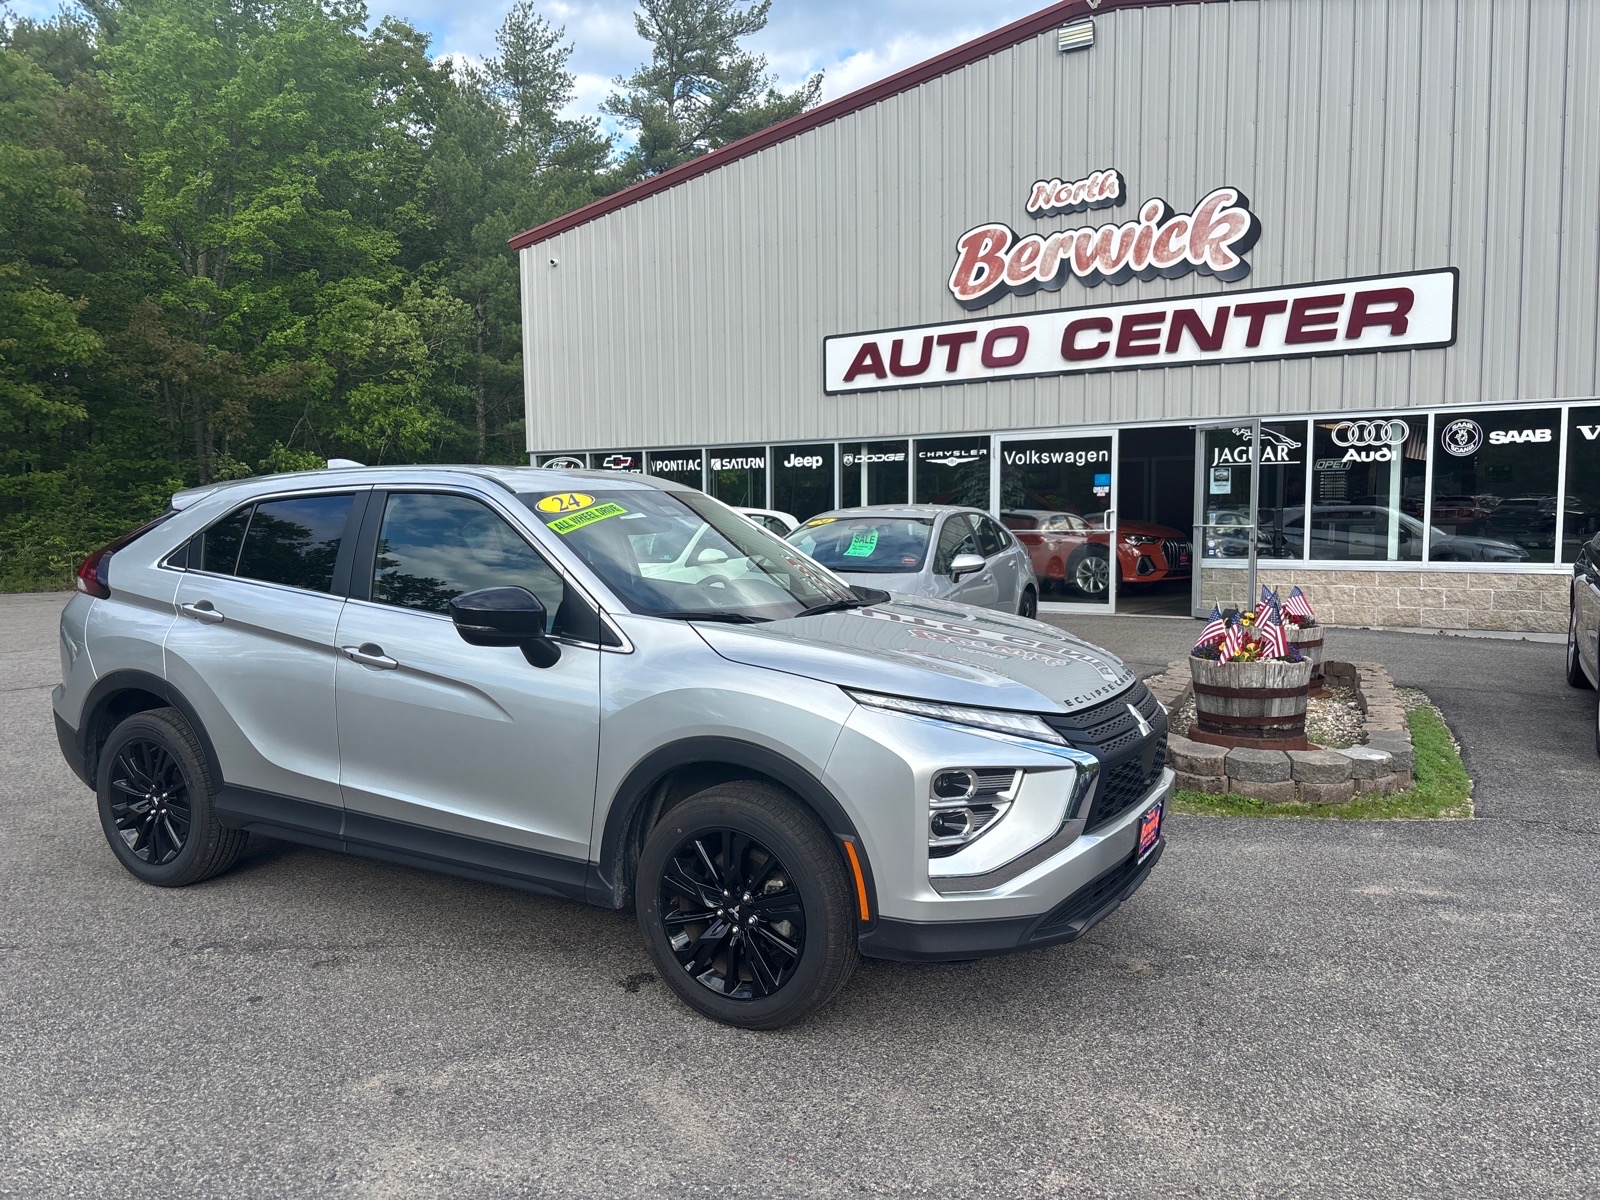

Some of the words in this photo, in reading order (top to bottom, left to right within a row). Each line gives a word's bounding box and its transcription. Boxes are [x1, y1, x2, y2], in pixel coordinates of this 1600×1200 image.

[1032, 172, 1119, 210] North
[953, 190, 1247, 299] Berwick
[843, 325, 1029, 382] AUTO
[1059, 287, 1416, 361] CENTER
[1452, 422, 1473, 430] SAAB
[1488, 429, 1552, 445] SAAB
[918, 449, 988, 458] CHRYSLER
[1341, 447, 1397, 462] Audi
[1450, 443, 1474, 453] SCANIA
[656, 459, 702, 472] PONTIAC
[722, 458, 765, 470] SATURN
[784, 453, 823, 469] Jeep
[854, 453, 906, 463] DODGE
[1004, 450, 1109, 466] Volkswagen
[551, 493, 581, 511] 24
[554, 519, 577, 532] ALL
[568, 510, 602, 525] WHEEL
[595, 504, 623, 516] DRIVE
[854, 534, 876, 545] SALE
[1064, 683, 1116, 707] ECLIPSE
[1114, 669, 1134, 687] CROSS
